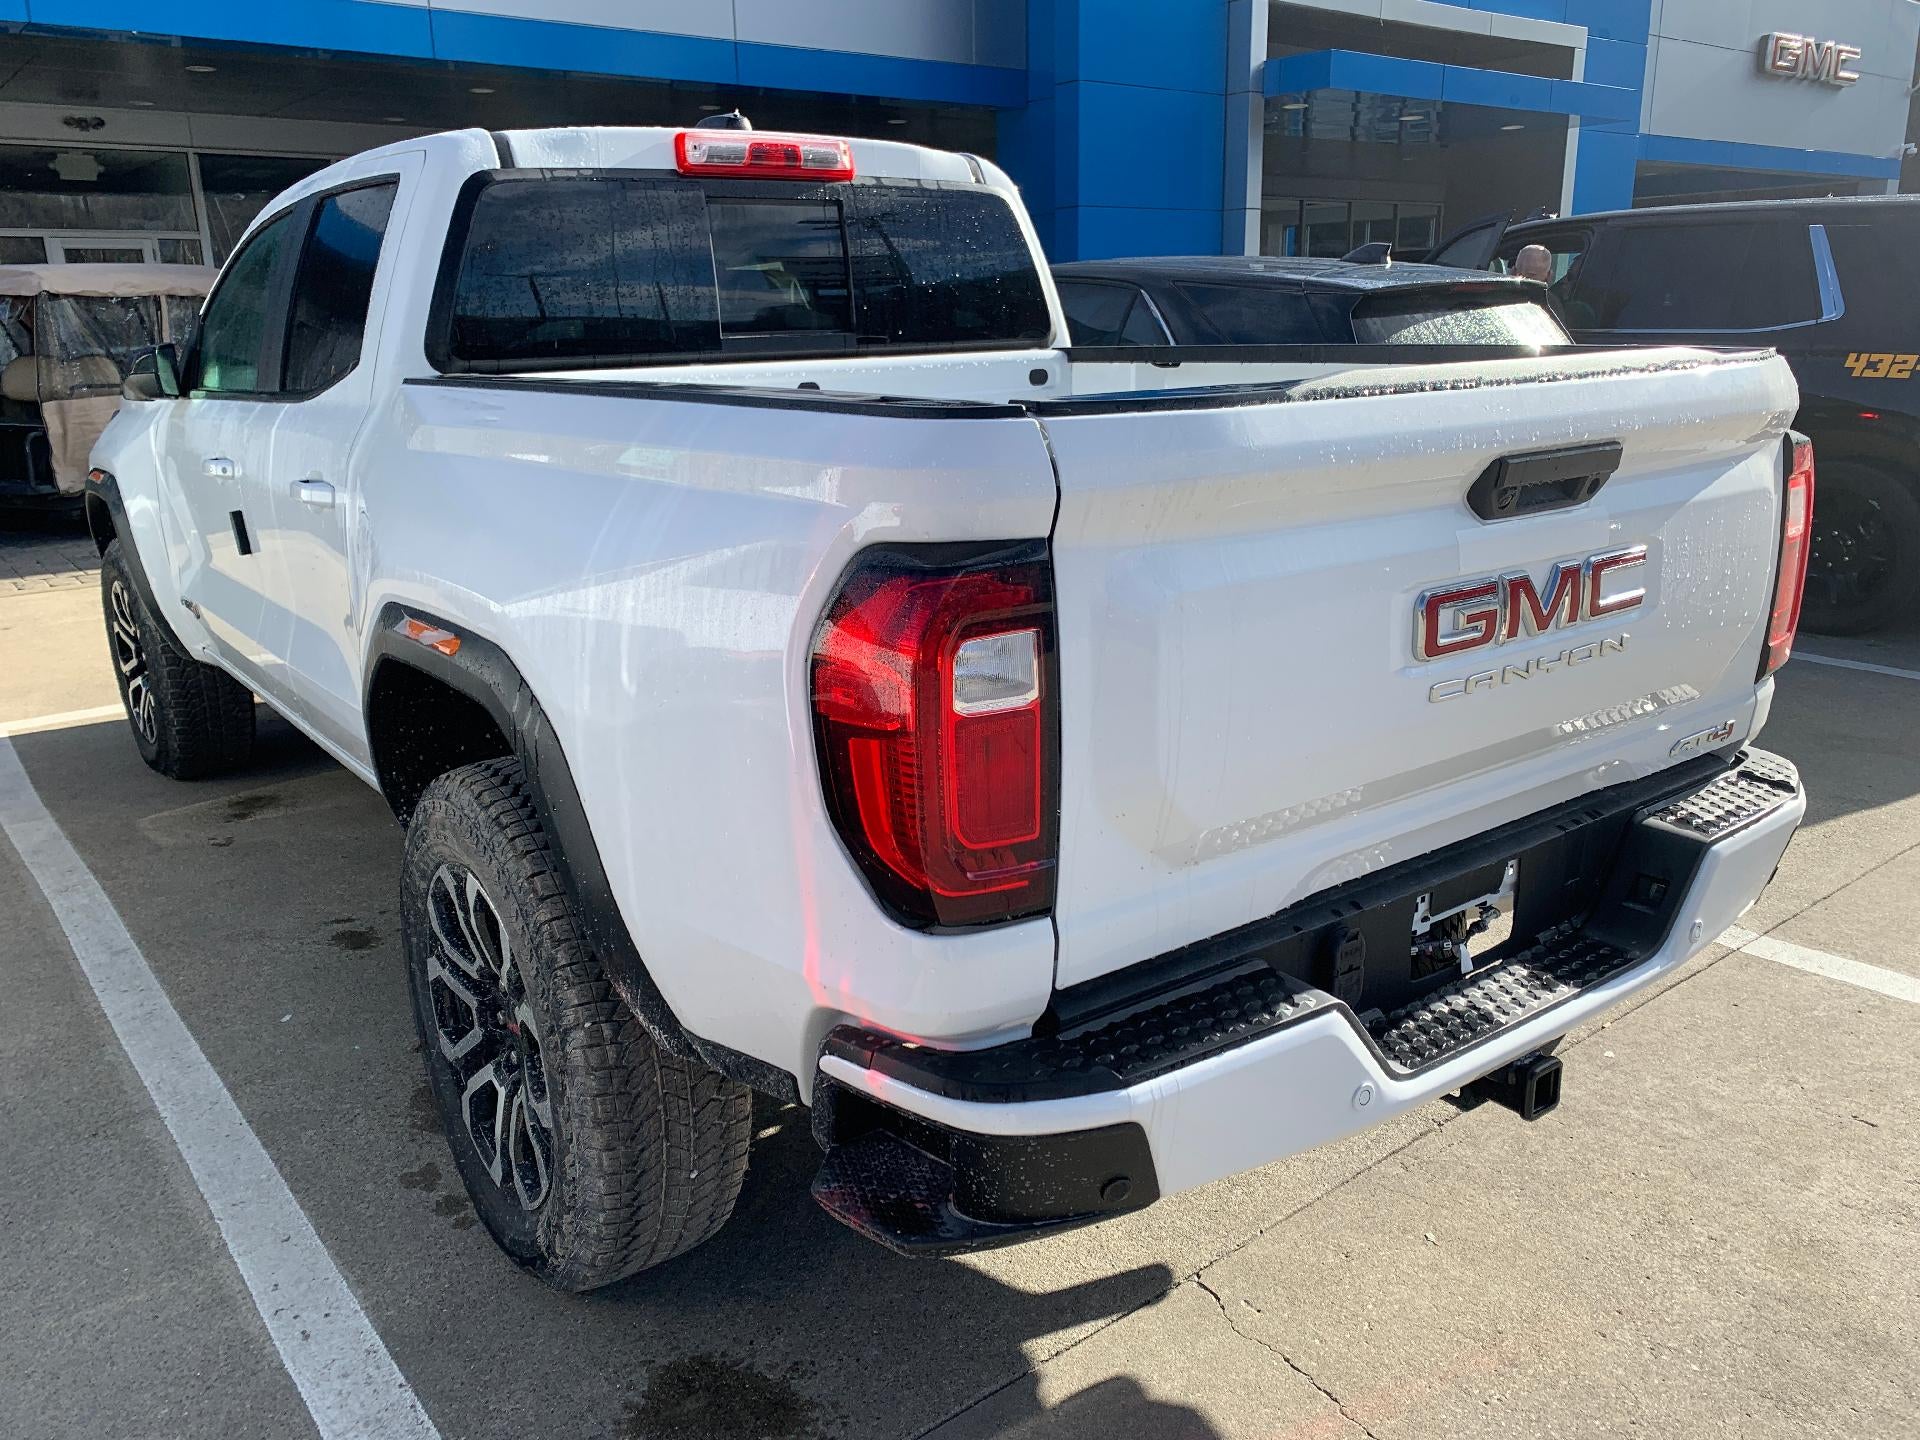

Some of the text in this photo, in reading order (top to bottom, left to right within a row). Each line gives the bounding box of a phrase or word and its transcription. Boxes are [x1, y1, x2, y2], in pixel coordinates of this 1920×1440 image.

[1764, 31, 1861, 86] GMC
[1413, 545, 1648, 662] GMC
[1429, 634, 1631, 703] CANYON
